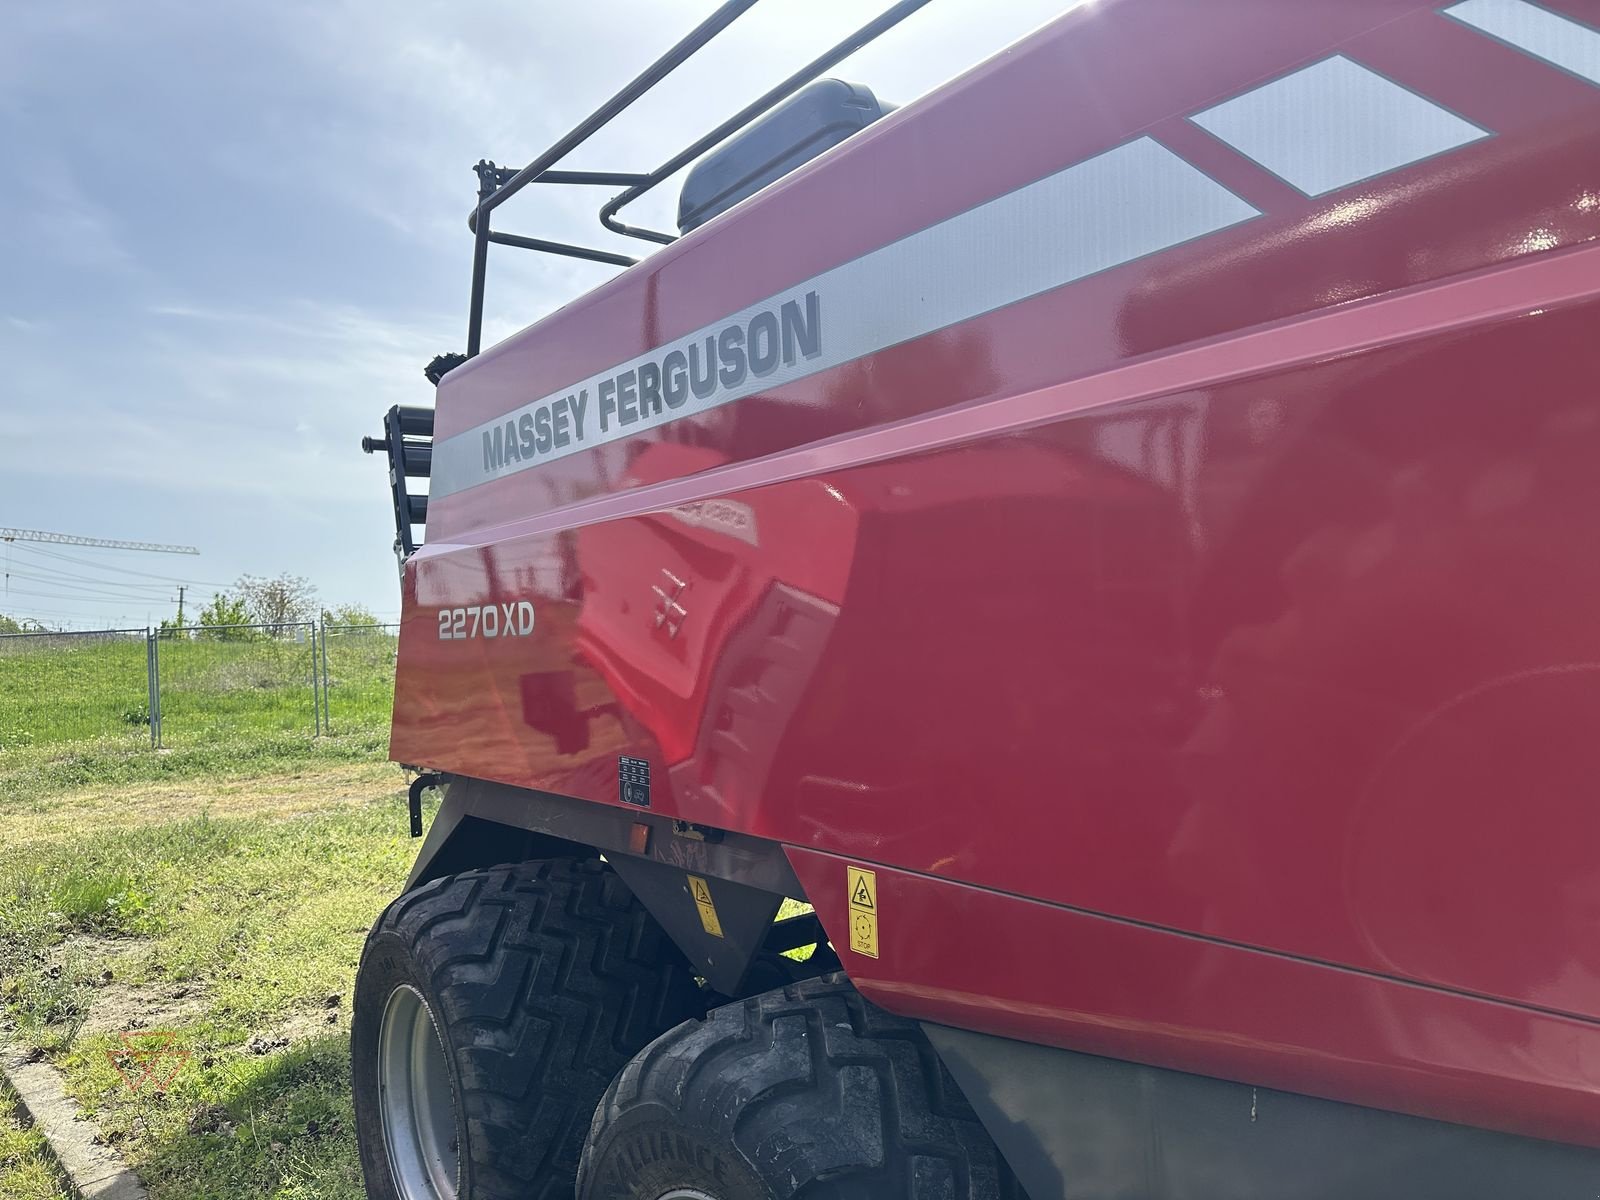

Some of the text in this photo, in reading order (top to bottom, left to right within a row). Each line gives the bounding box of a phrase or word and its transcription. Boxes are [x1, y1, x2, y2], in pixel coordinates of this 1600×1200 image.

[482, 290, 822, 474] MASSEY FERGUSON
[438, 601, 535, 639] 2270 XD
[857, 940, 871, 949] STOP
[615, 1131, 728, 1192] ALLIANCE
